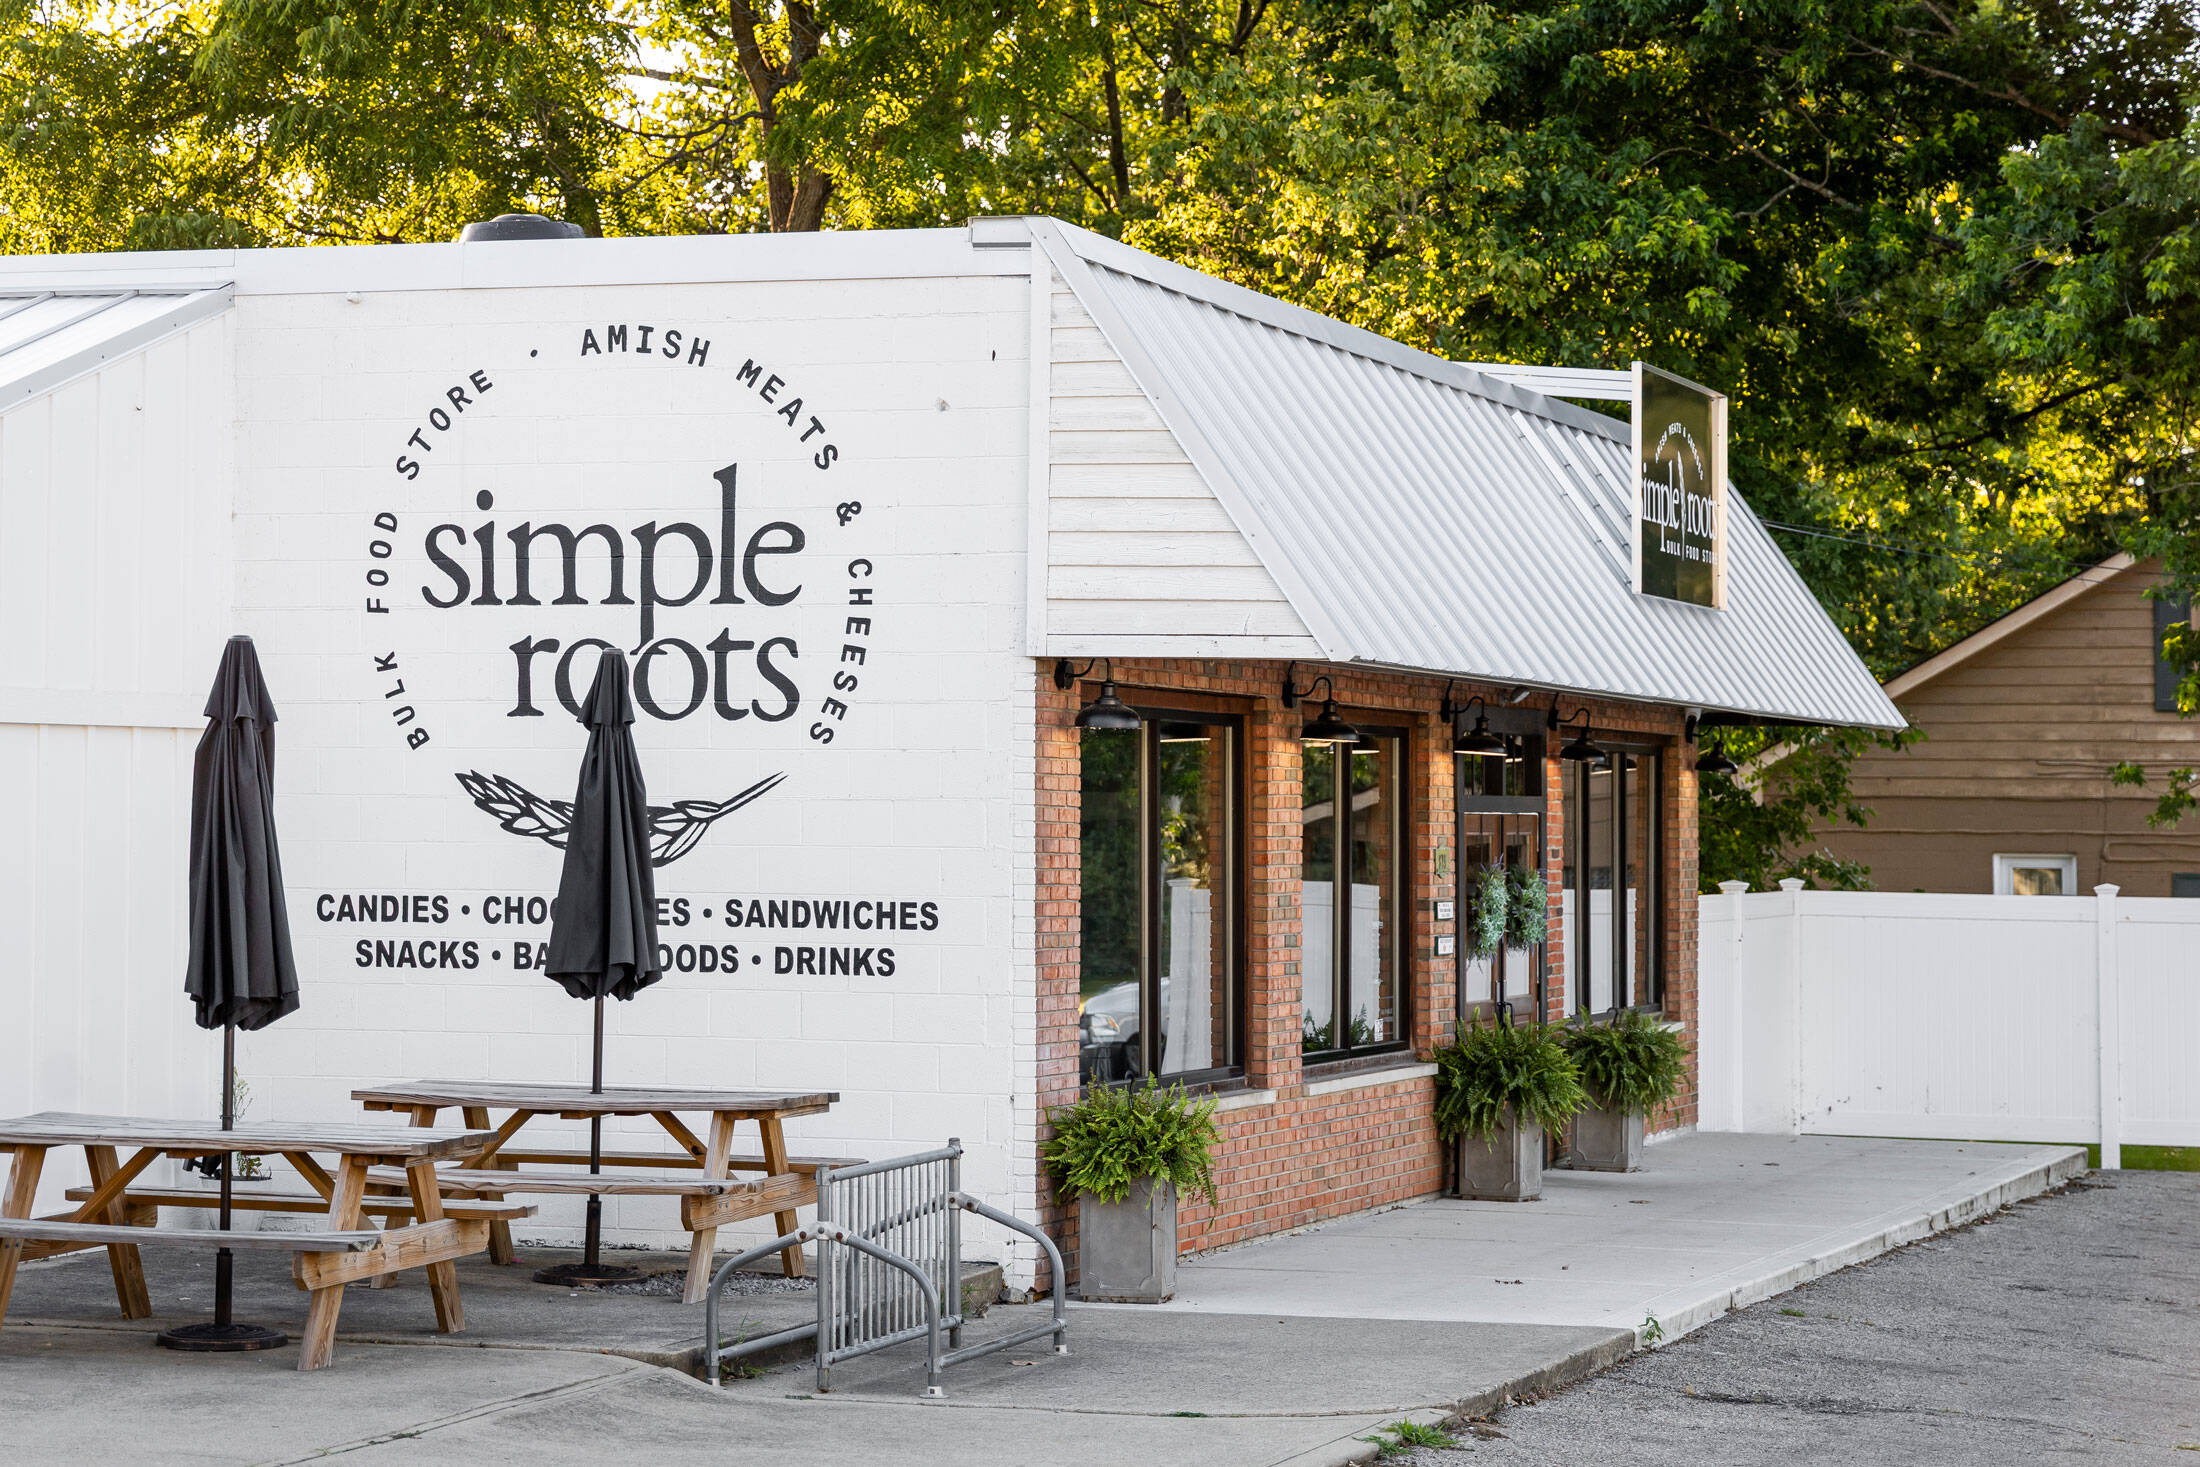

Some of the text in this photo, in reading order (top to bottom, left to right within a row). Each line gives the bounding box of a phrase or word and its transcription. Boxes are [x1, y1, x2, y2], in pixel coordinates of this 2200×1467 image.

[366, 324, 873, 751] BULK FOOD STORE AMISH MEATS & CHEESES
[1687, 491, 1717, 540] roots
[421, 462, 806, 656] simple
[1667, 540, 1681, 556] BULK
[1686, 545, 1700, 561] FOOD
[506, 627, 800, 722] roots
[316, 893, 940, 931] CANDIES CHOES SANDWICHES
[355, 939, 480, 970] SNACKS
[658, 943, 739, 974] OODS
[774, 946, 896, 977] DRINKS
